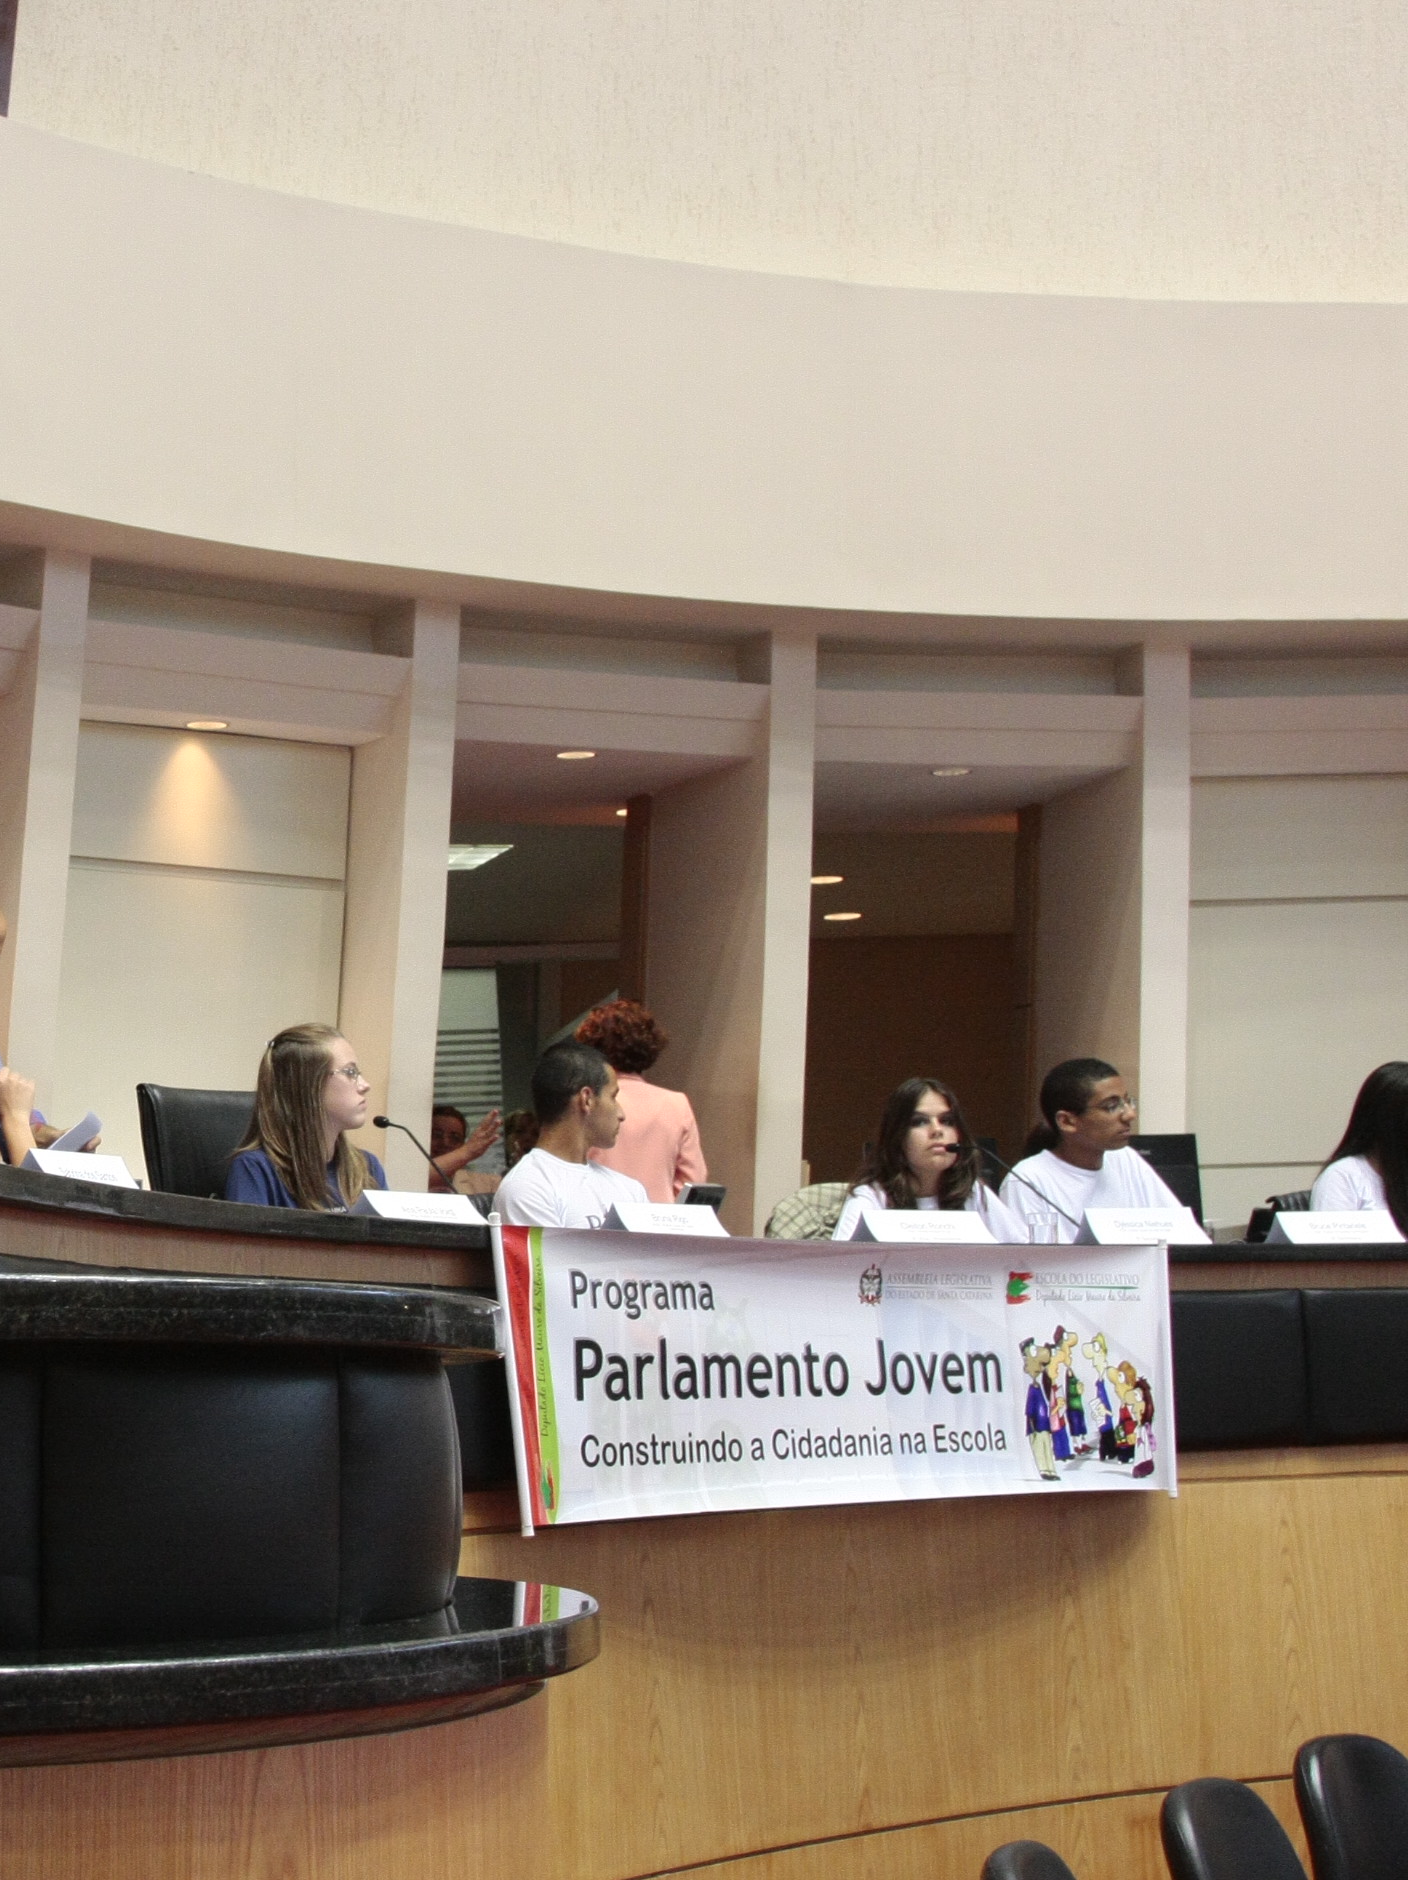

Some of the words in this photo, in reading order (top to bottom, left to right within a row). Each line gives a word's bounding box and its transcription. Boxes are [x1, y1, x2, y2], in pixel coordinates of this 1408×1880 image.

[532, 1255, 543, 1297] Silveira
[569, 1268, 715, 1320] Programa
[898, 1289, 925, 1300] ESTADO
[937, 1290, 958, 1300] SANTA
[959, 1290, 993, 1301] CATARINA
[940, 1273, 993, 1286] LEGISLATIVA
[1035, 1271, 1067, 1284] ESCOLA
[1069, 1272, 1083, 1285] DO
[1085, 1272, 1140, 1285] LEGISLATIVO
[533, 1301, 542, 1314] da
[573, 1335, 849, 1401] Parlamento
[864, 1337, 1003, 1396] Jovem
[538, 1386, 550, 1437] Deputado
[580, 1430, 743, 1468] Construindo
[750, 1437, 765, 1461] a
[772, 1426, 893, 1460] Cidadania
[899, 1432, 927, 1455] na
[933, 1422, 1007, 1453] Escola
